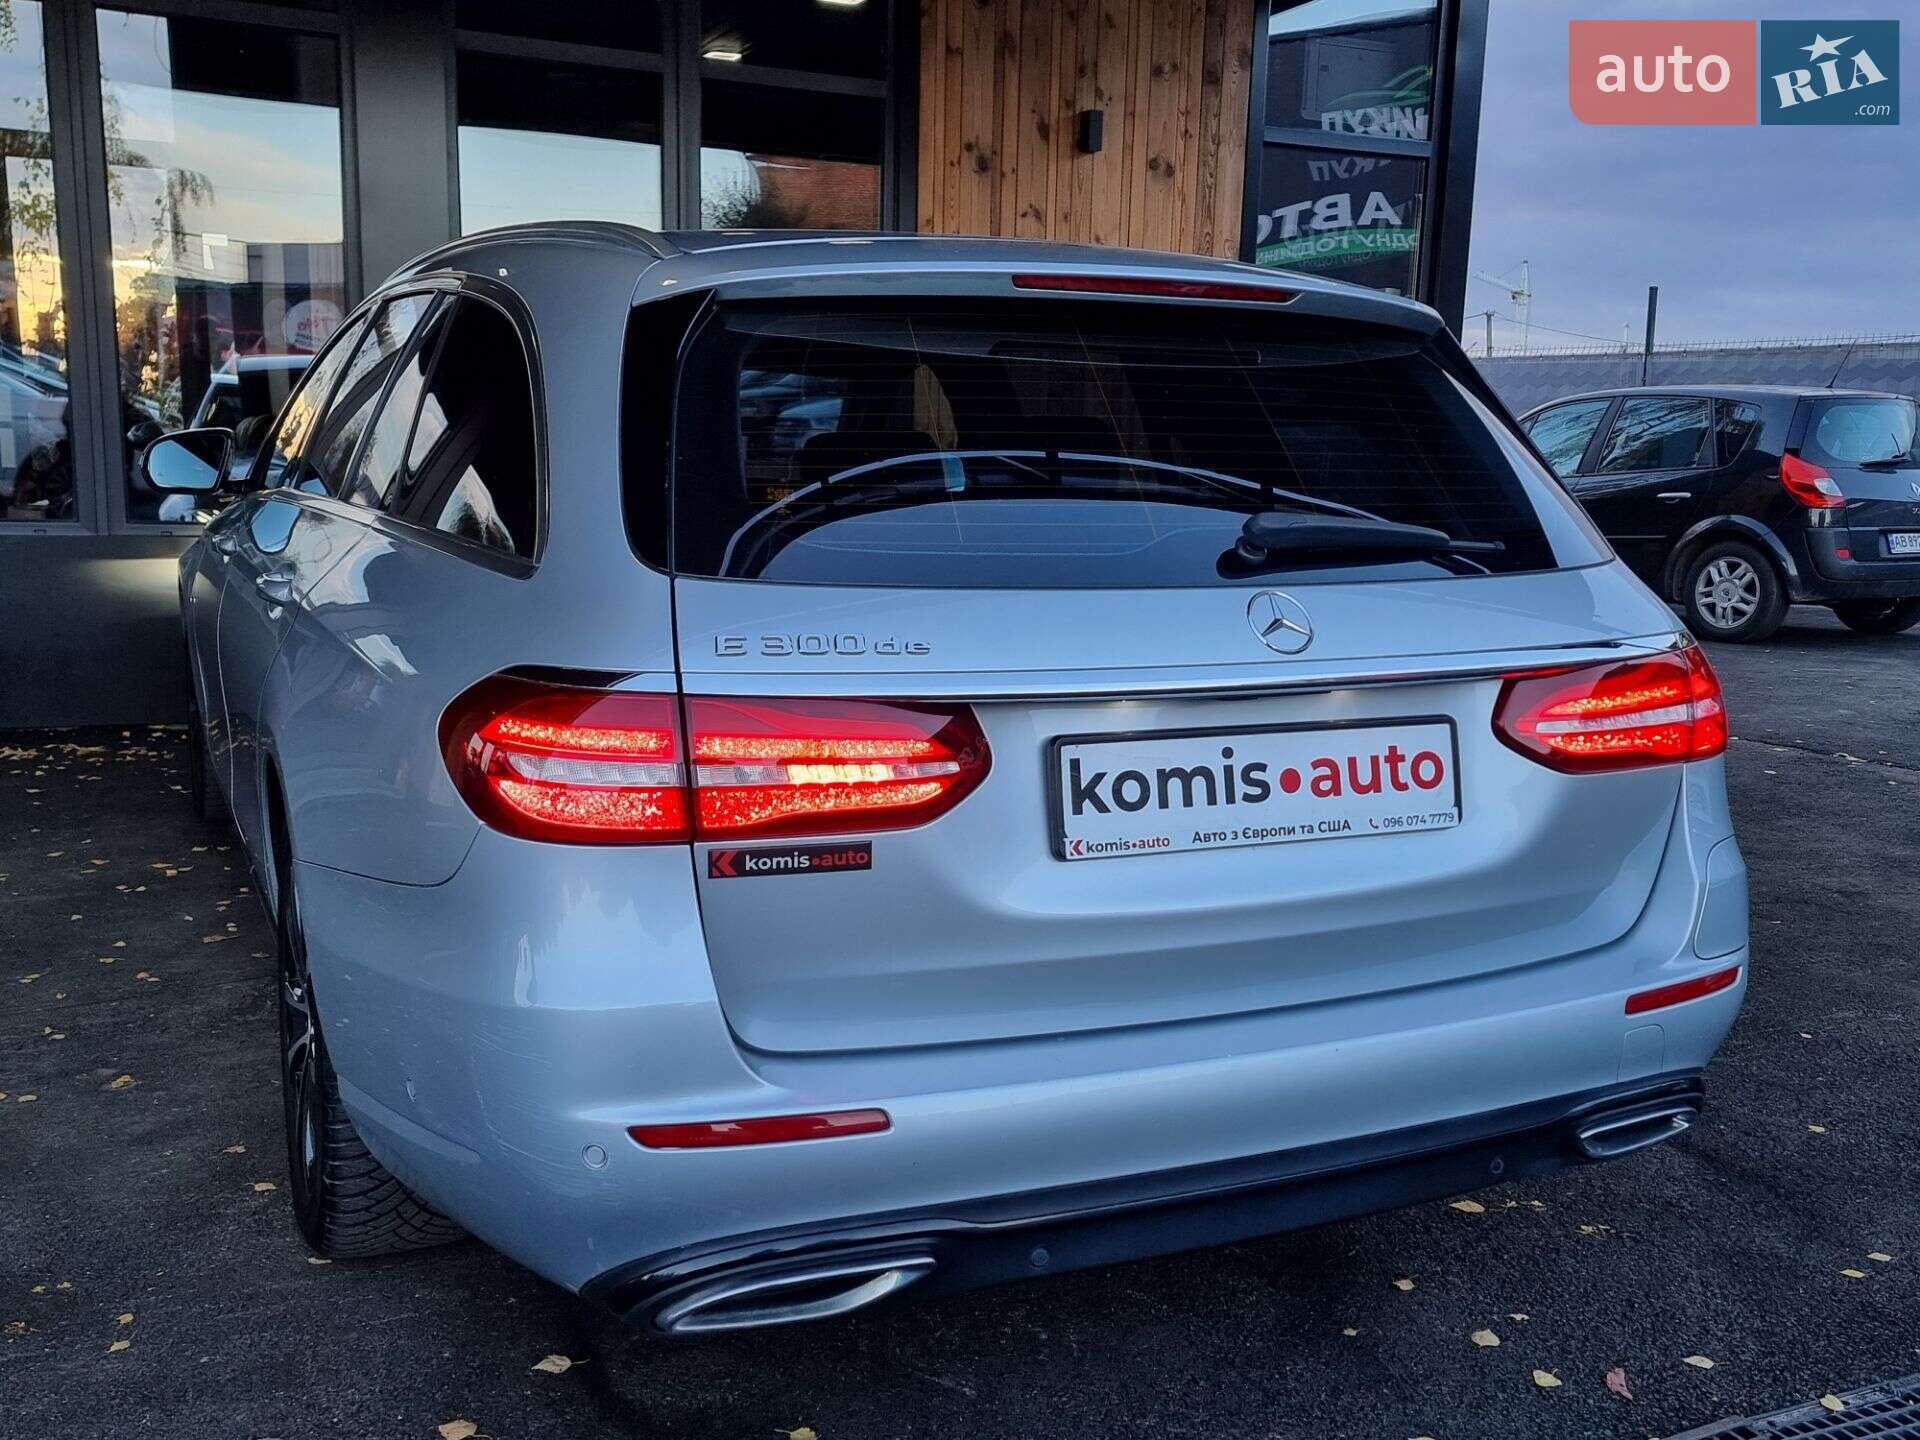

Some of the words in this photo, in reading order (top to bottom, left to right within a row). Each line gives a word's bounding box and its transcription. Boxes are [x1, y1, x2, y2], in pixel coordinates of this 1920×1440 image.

[715, 635, 748, 657] E
[1192, 830, 1227, 844] Авто
[1242, 826, 1296, 841] Європи
[1300, 824, 1314, 834] та
[1318, 819, 1352, 833] США
[1383, 816, 1403, 829] 096
[1406, 814, 1427, 827] 074
[1429, 812, 1455, 825] 7779
